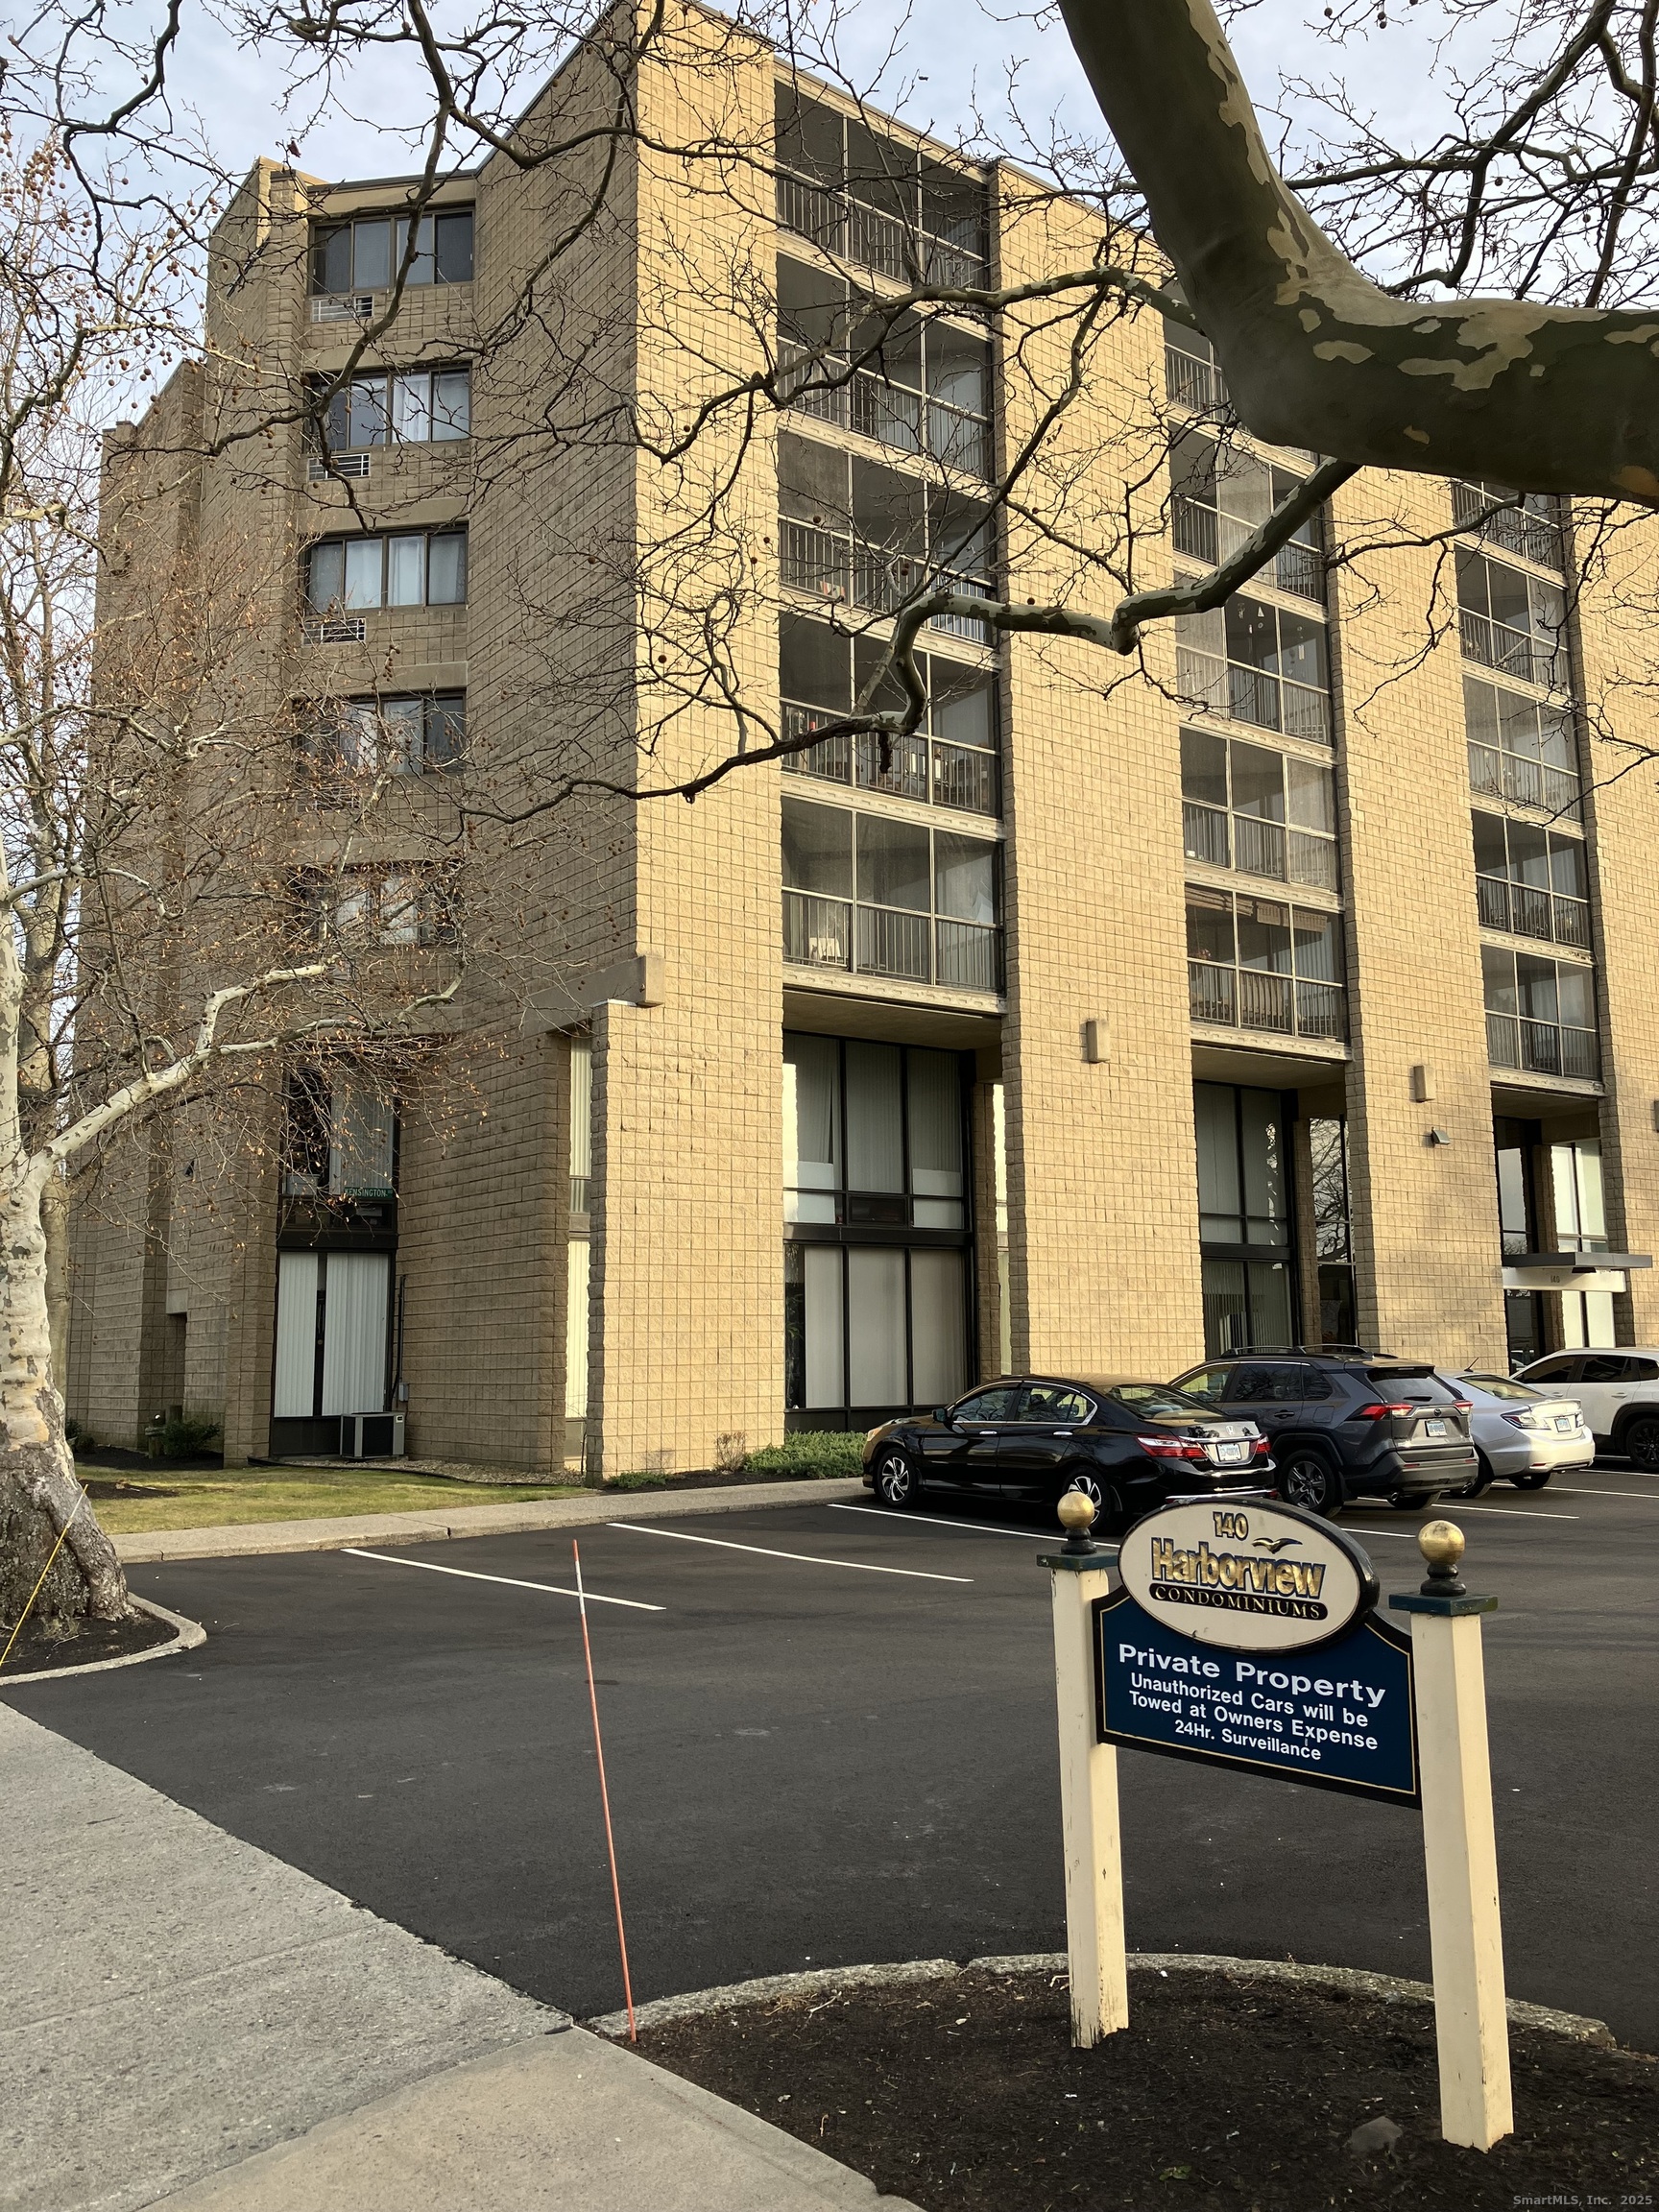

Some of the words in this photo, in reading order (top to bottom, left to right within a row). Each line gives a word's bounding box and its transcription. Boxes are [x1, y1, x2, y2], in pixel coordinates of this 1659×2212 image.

[1213, 1511, 1249, 1540] 140
[1151, 1537, 1326, 1599] Harborview
[1155, 1585, 1320, 1619] CONDOMINIUMS
[1118, 1643, 1220, 1678] Private
[1236, 1662, 1385, 1707] Property
[1131, 1672, 1242, 1706] Unauthorized
[1251, 1693, 1294, 1715] Cars
[1303, 1703, 1334, 1721] will
[1343, 1708, 1368, 1727] be
[1129, 1691, 1181, 1714] Towed
[1190, 1701, 1206, 1719] at
[1214, 1706, 1283, 1732] Owners
[1291, 1720, 1378, 1749] Expense
[1174, 1719, 1215, 1740] 24Hr.
[1221, 1728, 1321, 1760] Surveillance
